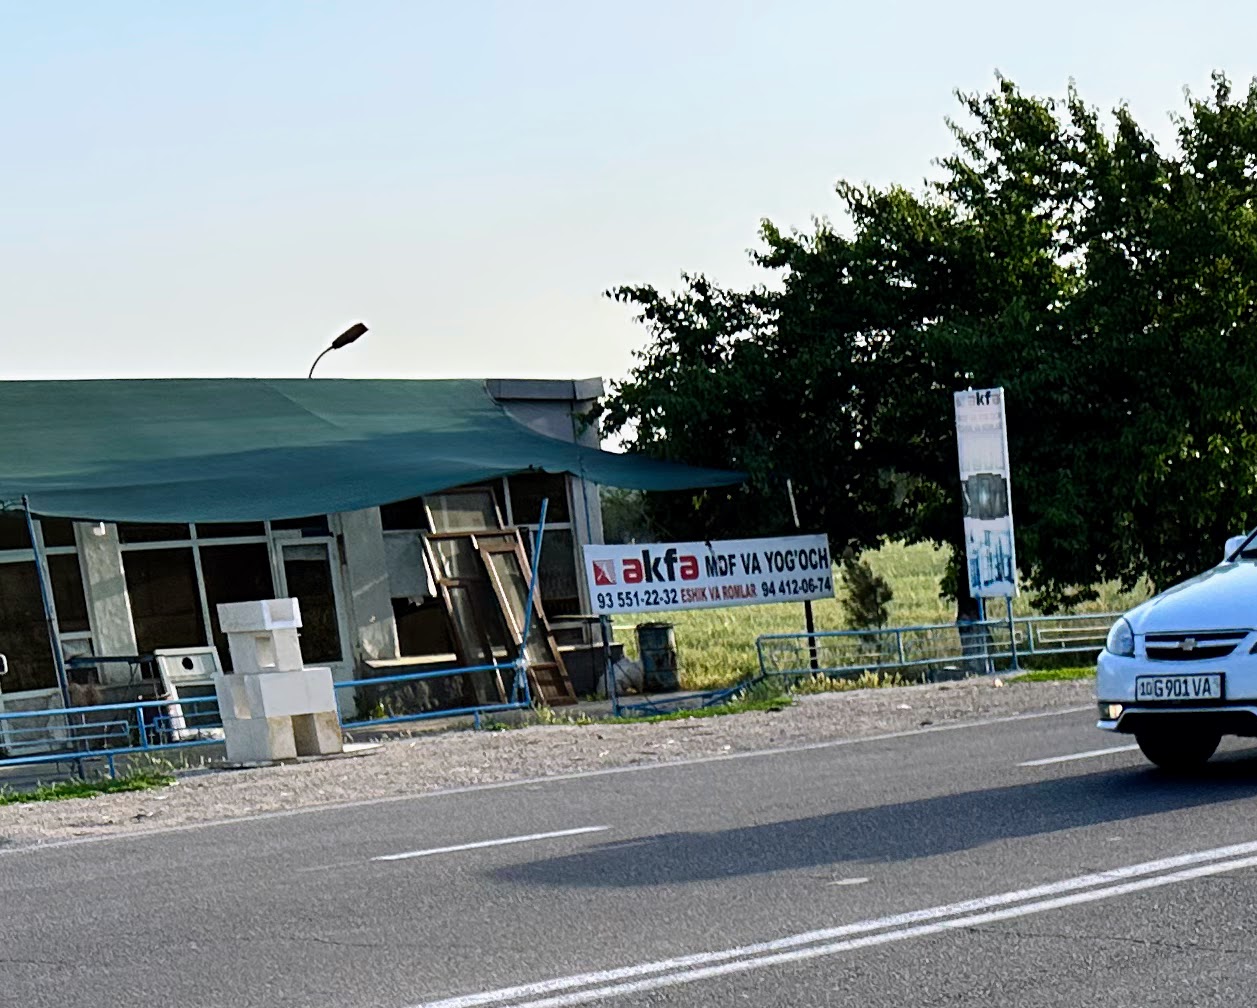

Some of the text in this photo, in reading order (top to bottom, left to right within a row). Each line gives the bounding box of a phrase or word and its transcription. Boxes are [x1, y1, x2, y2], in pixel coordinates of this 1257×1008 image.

[622, 548, 829, 584] akfa MDF VA YOG'OCH
[681, 586, 708, 603] ESHIK
[708, 585, 720, 601] VA
[761, 577, 832, 597] 94 412-06-74
[597, 589, 678, 609] 93 551-22-32
